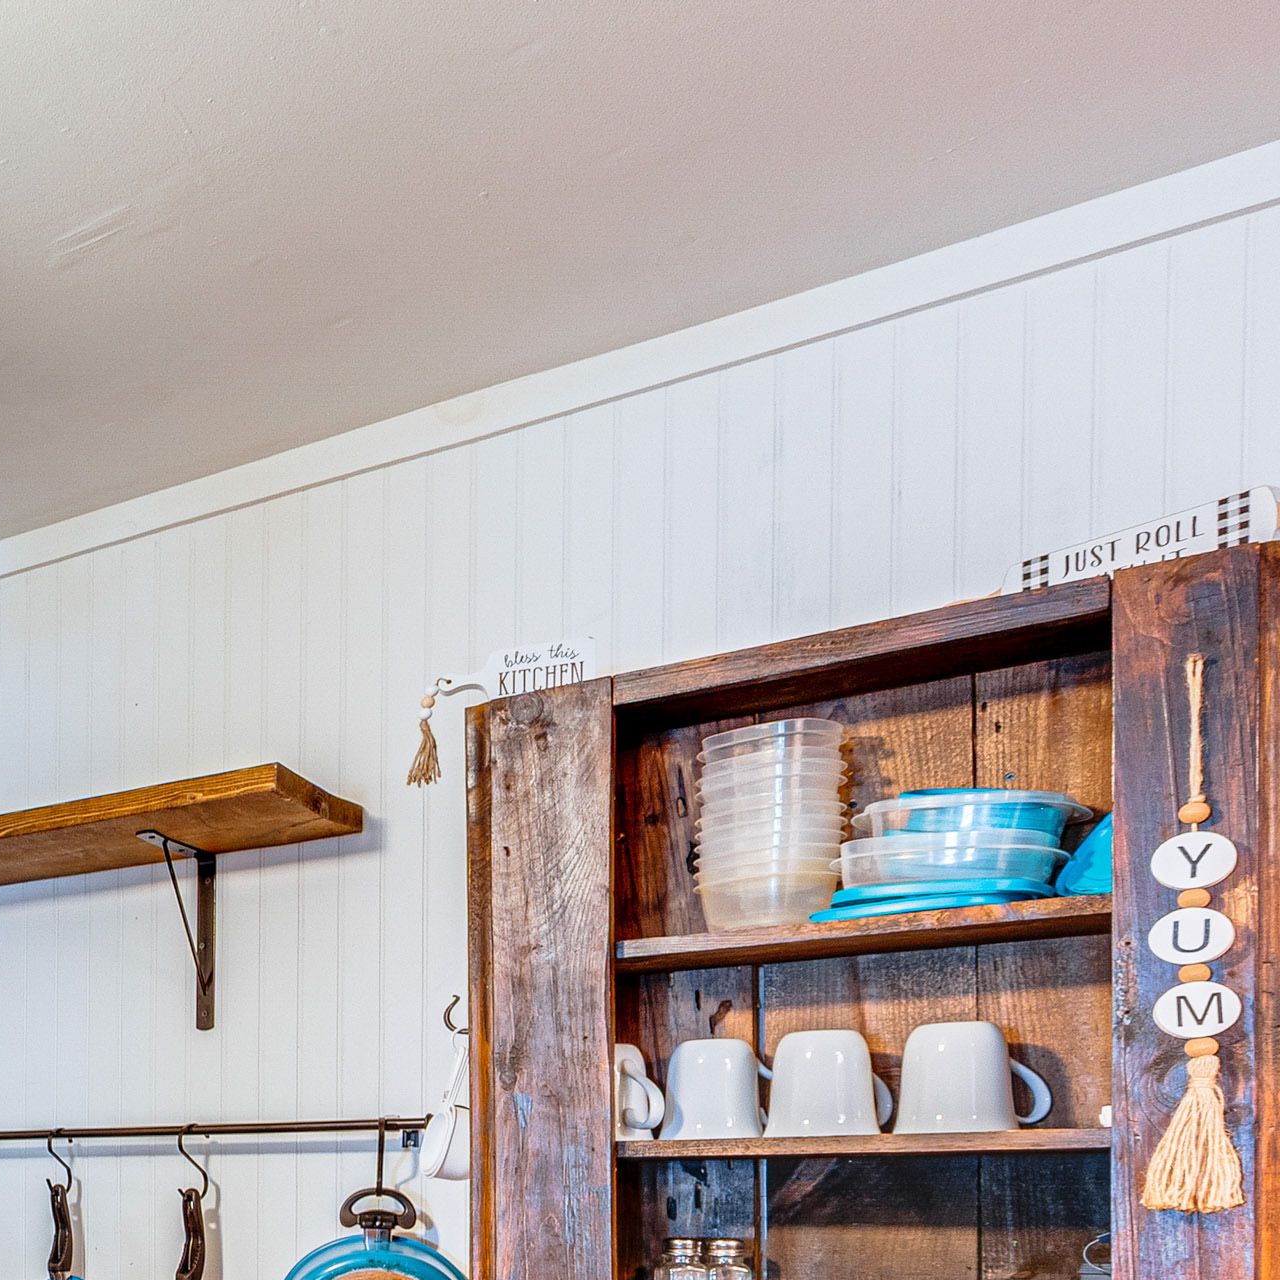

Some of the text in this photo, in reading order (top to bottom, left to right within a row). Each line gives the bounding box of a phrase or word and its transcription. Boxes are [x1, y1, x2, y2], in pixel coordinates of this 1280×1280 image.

[1063, 538, 1121, 578] JUST
[1136, 515, 1204, 554] ROLL
[504, 643, 580, 668] bless this
[498, 661, 584, 696] KITCHEN
